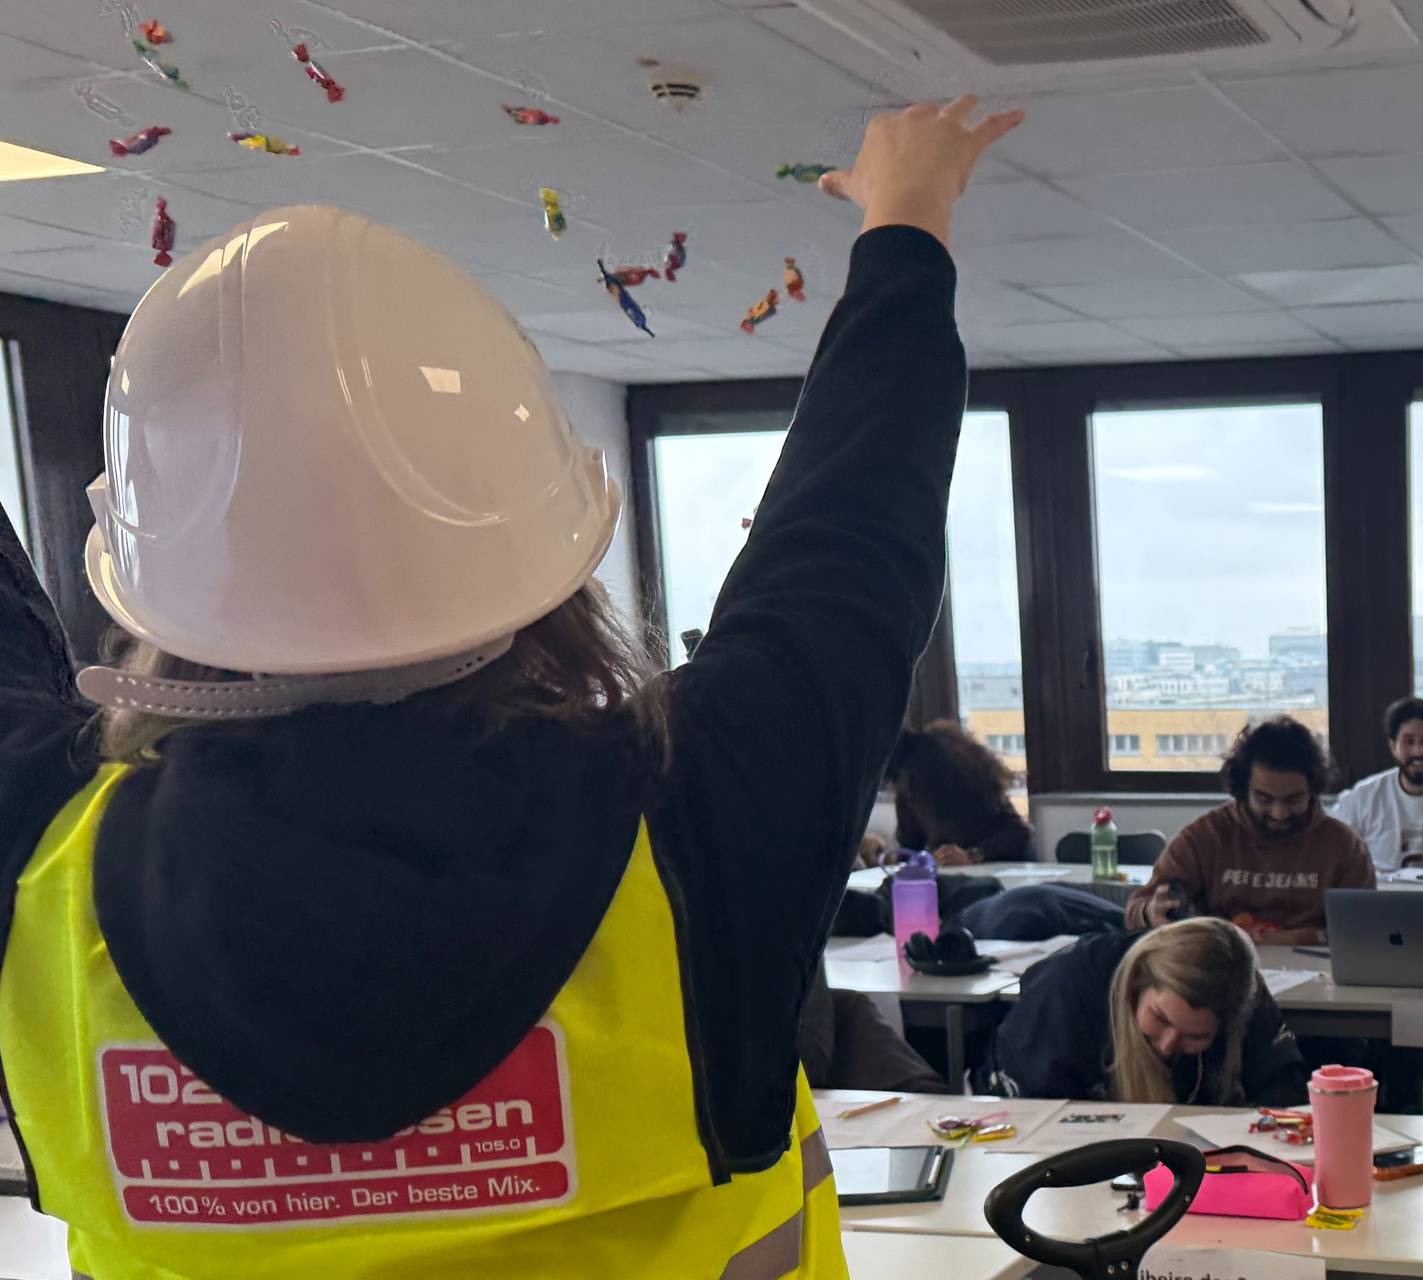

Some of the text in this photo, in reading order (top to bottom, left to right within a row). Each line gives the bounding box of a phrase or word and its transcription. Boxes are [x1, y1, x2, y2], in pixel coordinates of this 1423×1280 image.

[156, 1099, 535, 1148] radi sen
[474, 1137, 522, 1154] 105.0
[232, 1199, 278, 1217] von
[286, 1192, 341, 1213] hier.
[351, 1187, 398, 1208] Der
[407, 1183, 479, 1204] beste
[488, 1174, 541, 1198] Mix.
